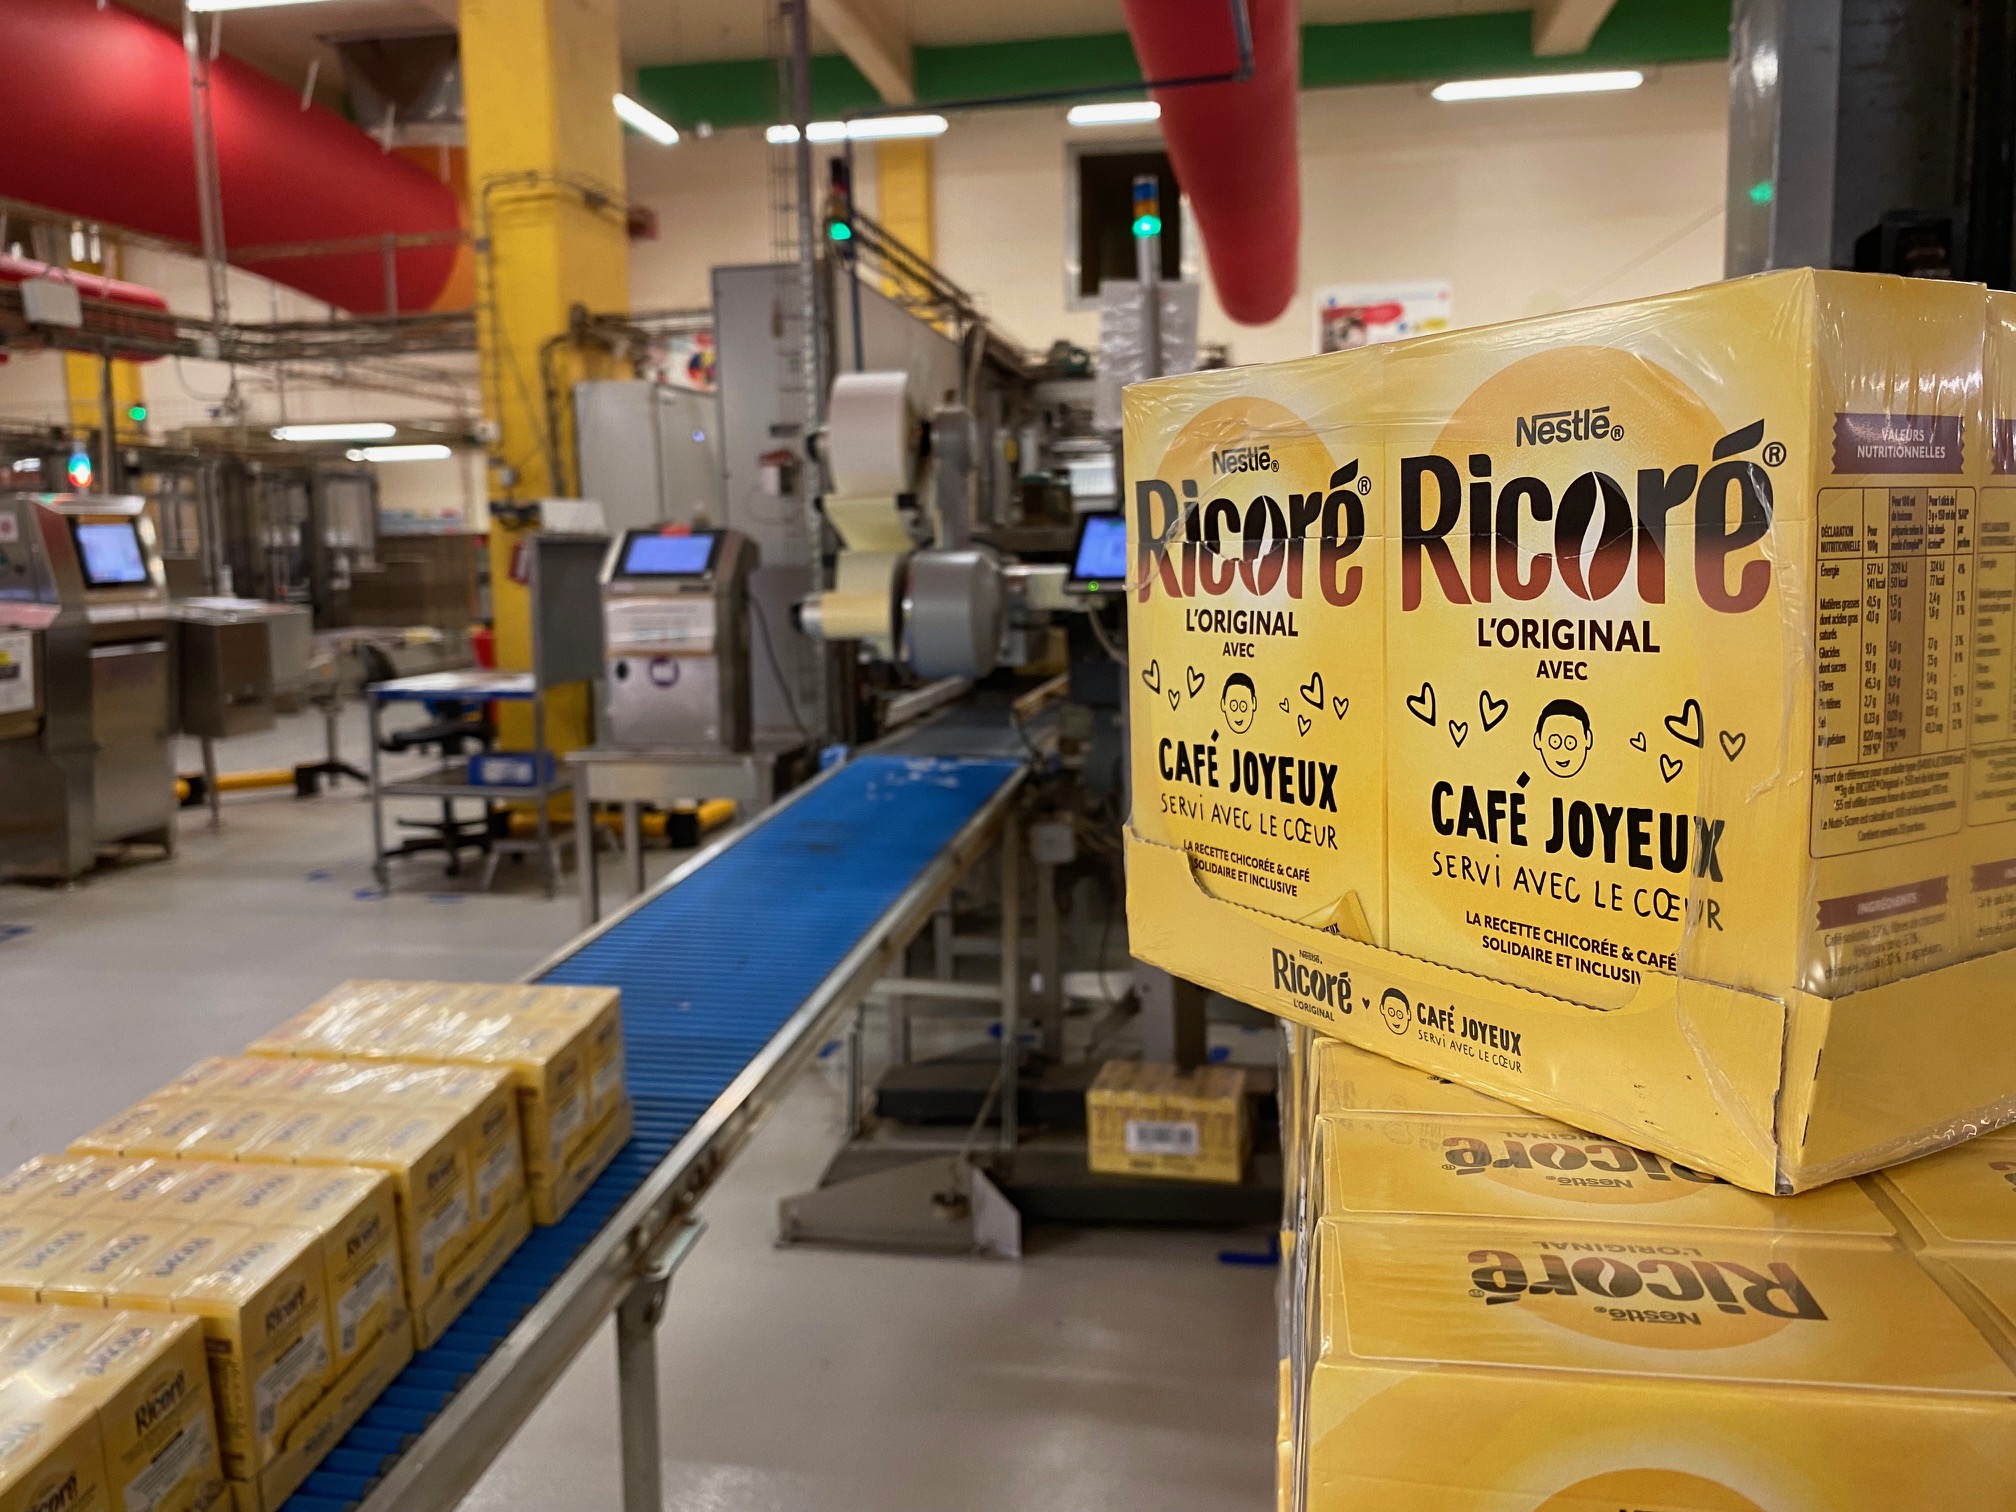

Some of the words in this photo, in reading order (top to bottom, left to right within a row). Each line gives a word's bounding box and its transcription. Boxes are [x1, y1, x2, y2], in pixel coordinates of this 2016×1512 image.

[1857, 445, 1946, 459] NUTRITIONNELLES
[1882, 428, 1924, 442] VALEURS
[1185, 608, 1299, 637] L'ORIGINAL
[1477, 617, 1660, 654] L'ORIGINAL
[1222, 641, 1255, 659] AVEC
[1536, 660, 1588, 681] AVEC
[1159, 729, 1219, 788] CAFÉ
[1230, 749, 1338, 813] JOYEUX
[1211, 803, 1252, 831] AVEC
[1260, 812, 1277, 837] LE
[1431, 770, 1531, 847] CAFÉ
[1545, 796, 1726, 883] JOYEUX
[1184, 839, 1194, 852] LA
[1195, 843, 1229, 861] RECETTE
[1231, 851, 1275, 874] CHICORÉE
[1277, 865, 1285, 876] &
[1286, 868, 1310, 883] CAFÉ
[1194, 858, 1236, 880] SOLIDAIRE
[1238, 869, 1248, 883] ET
[1250, 874, 1297, 897] INCLUSIVE
[1513, 866, 1580, 903] AVEC
[1595, 880, 1623, 912] LE
[1466, 910, 1481, 927] LA
[1484, 915, 1541, 941] RECETTE
[1543, 928, 1618, 958] CHICORÉE
[1622, 946, 1634, 962] &
[1637, 949, 1677, 971] CAFÉ
[1482, 935, 1552, 964] SOLIDAIRE
[1556, 953, 1572, 970] ET
[1417, 1002, 1455, 1034] CAFÉ
[1460, 1015, 1522, 1057] JOYEUX
[1449, 1040, 1475, 1058] AVEC
[1478, 1050, 1489, 1063] LE
[1532, 1240, 1703, 1257] L'ORIGINAL
